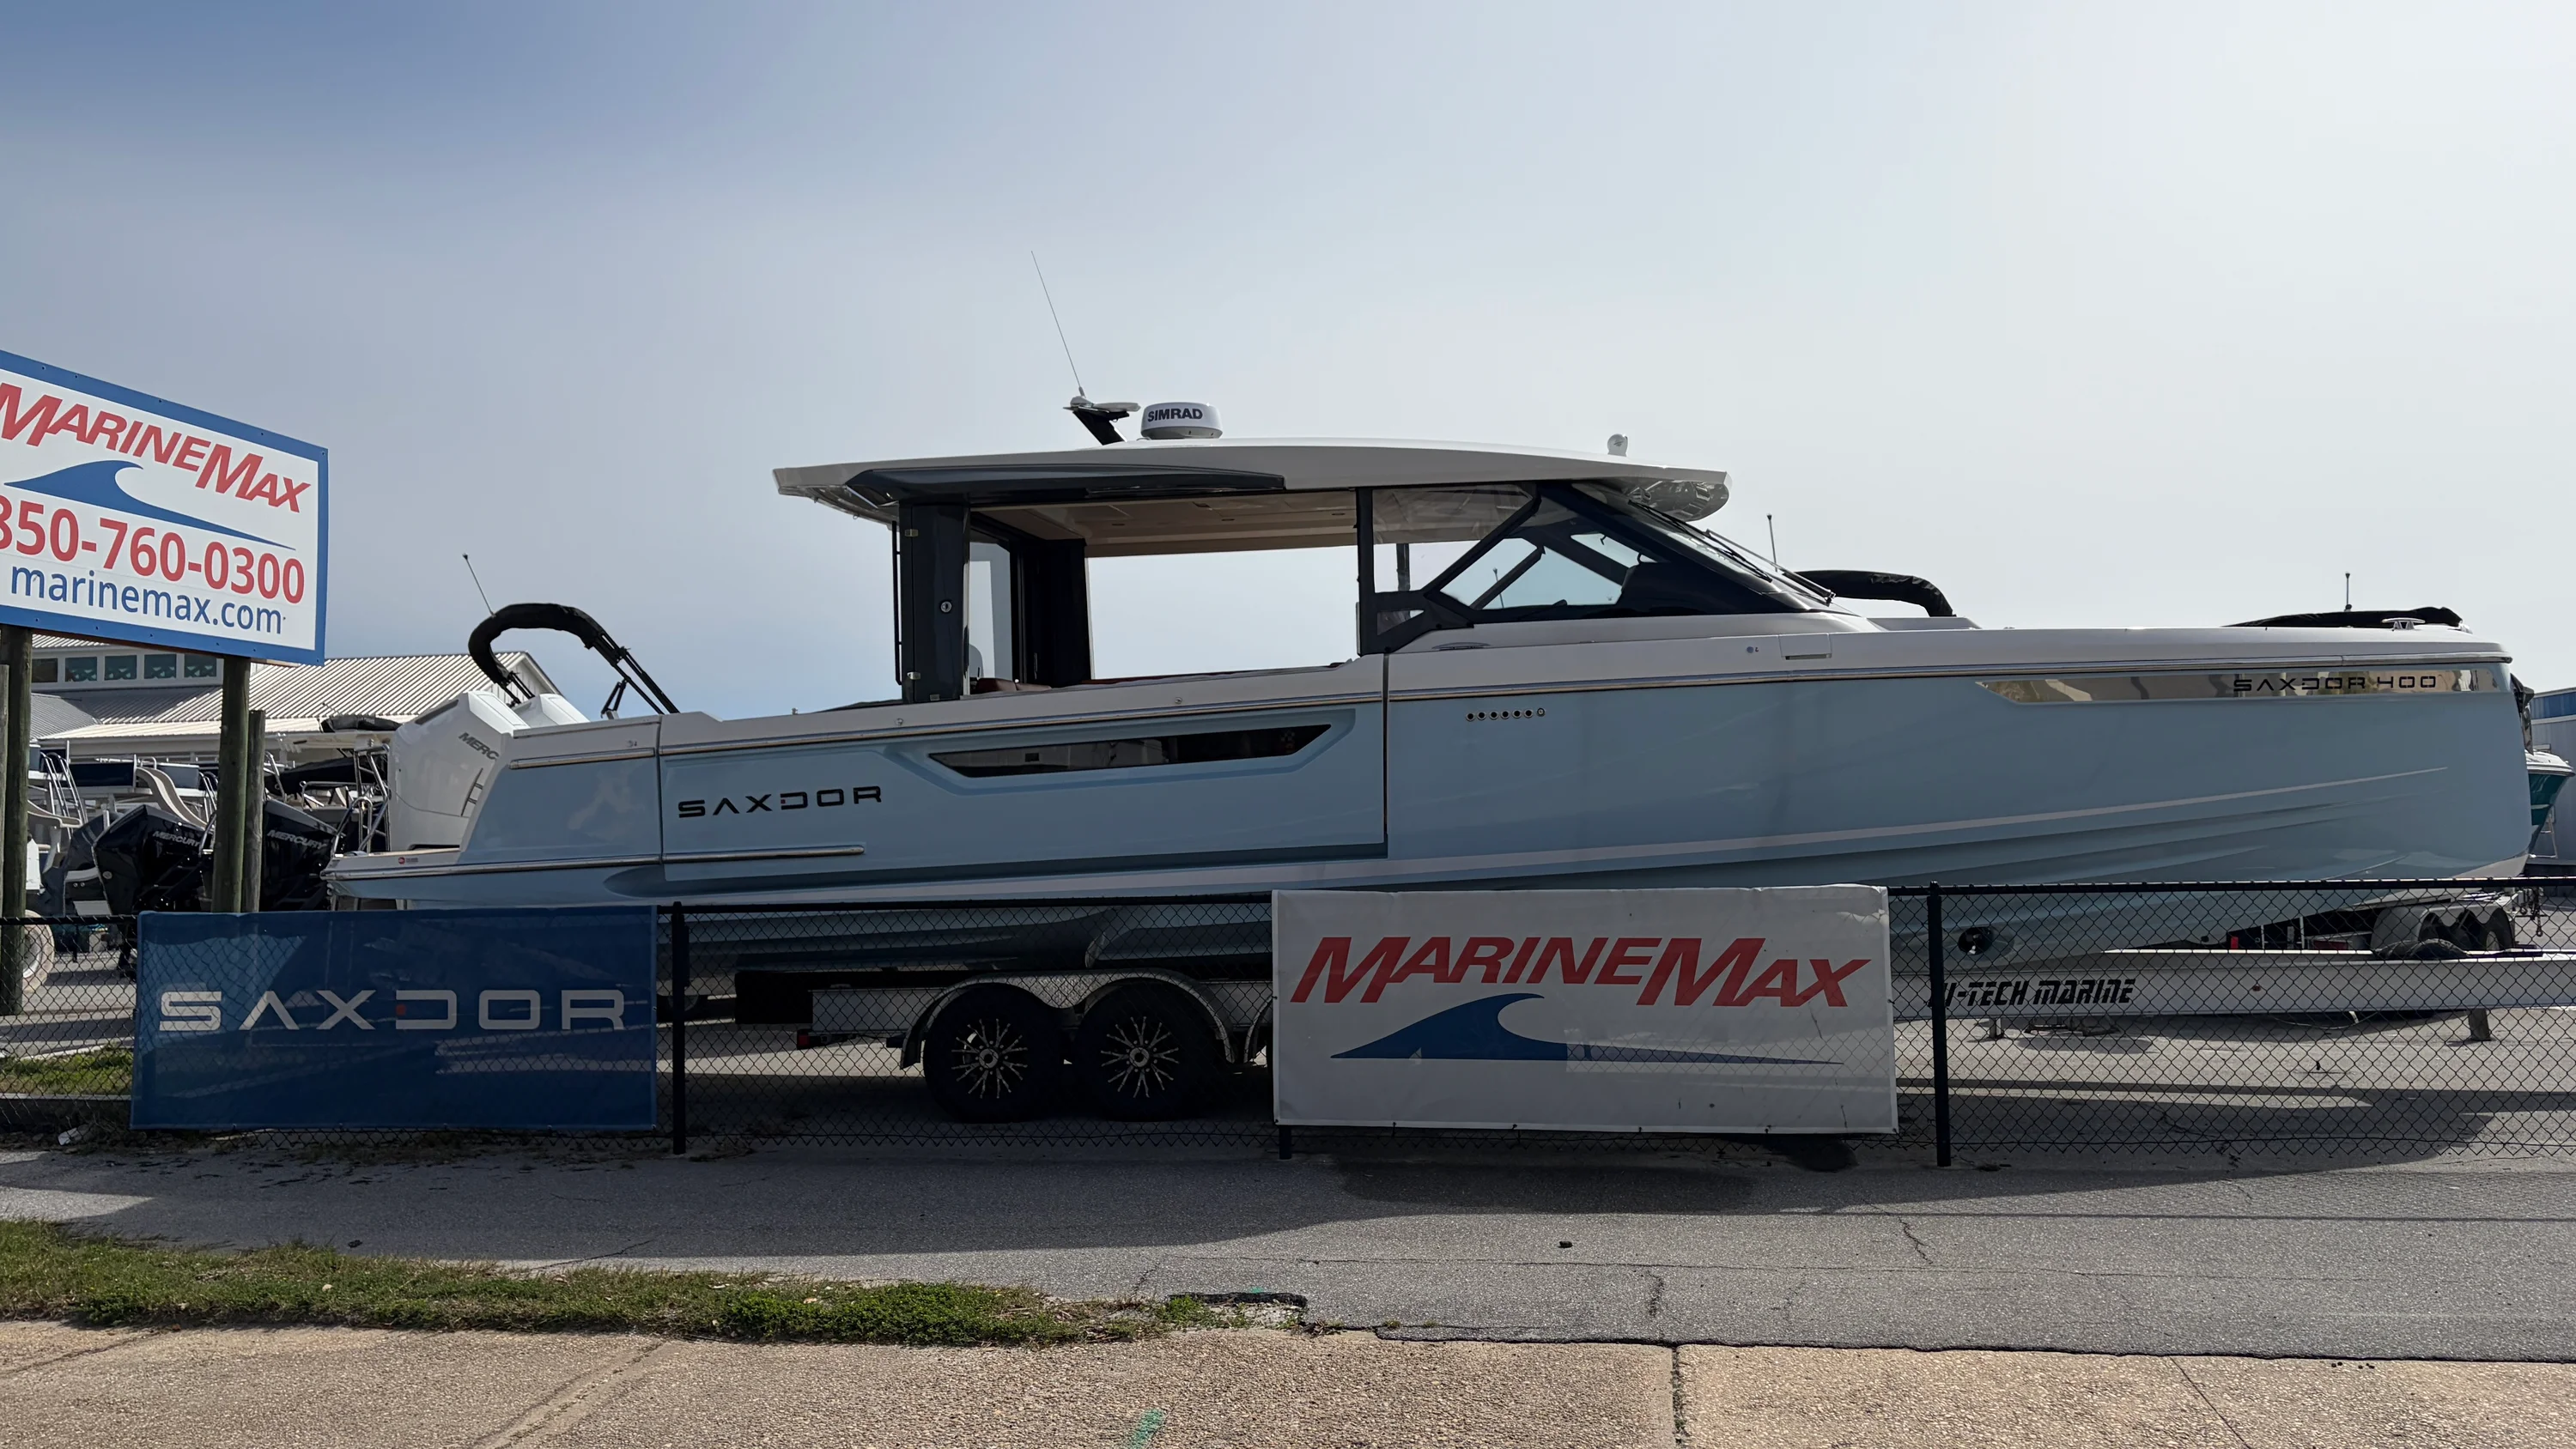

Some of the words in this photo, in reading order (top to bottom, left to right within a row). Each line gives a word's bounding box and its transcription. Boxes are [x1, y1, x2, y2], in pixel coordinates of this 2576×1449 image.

[1147, 408, 1203, 422] SIMRAD
[11, 566, 282, 634] marinemax.com
[2233, 676, 2366, 692] SAXDOR
[458, 731, 500, 761] MERC
[677, 785, 882, 818] SAXDOR
[152, 829, 200, 847] MERCURY
[267, 829, 326, 850] MERCURY
[1290, 936, 1872, 1007] MARINEMAX
[1929, 980, 2029, 1008] I-TECH
[2032, 979, 2136, 1005] MARINE
[159, 989, 625, 1031] SAXDOR
